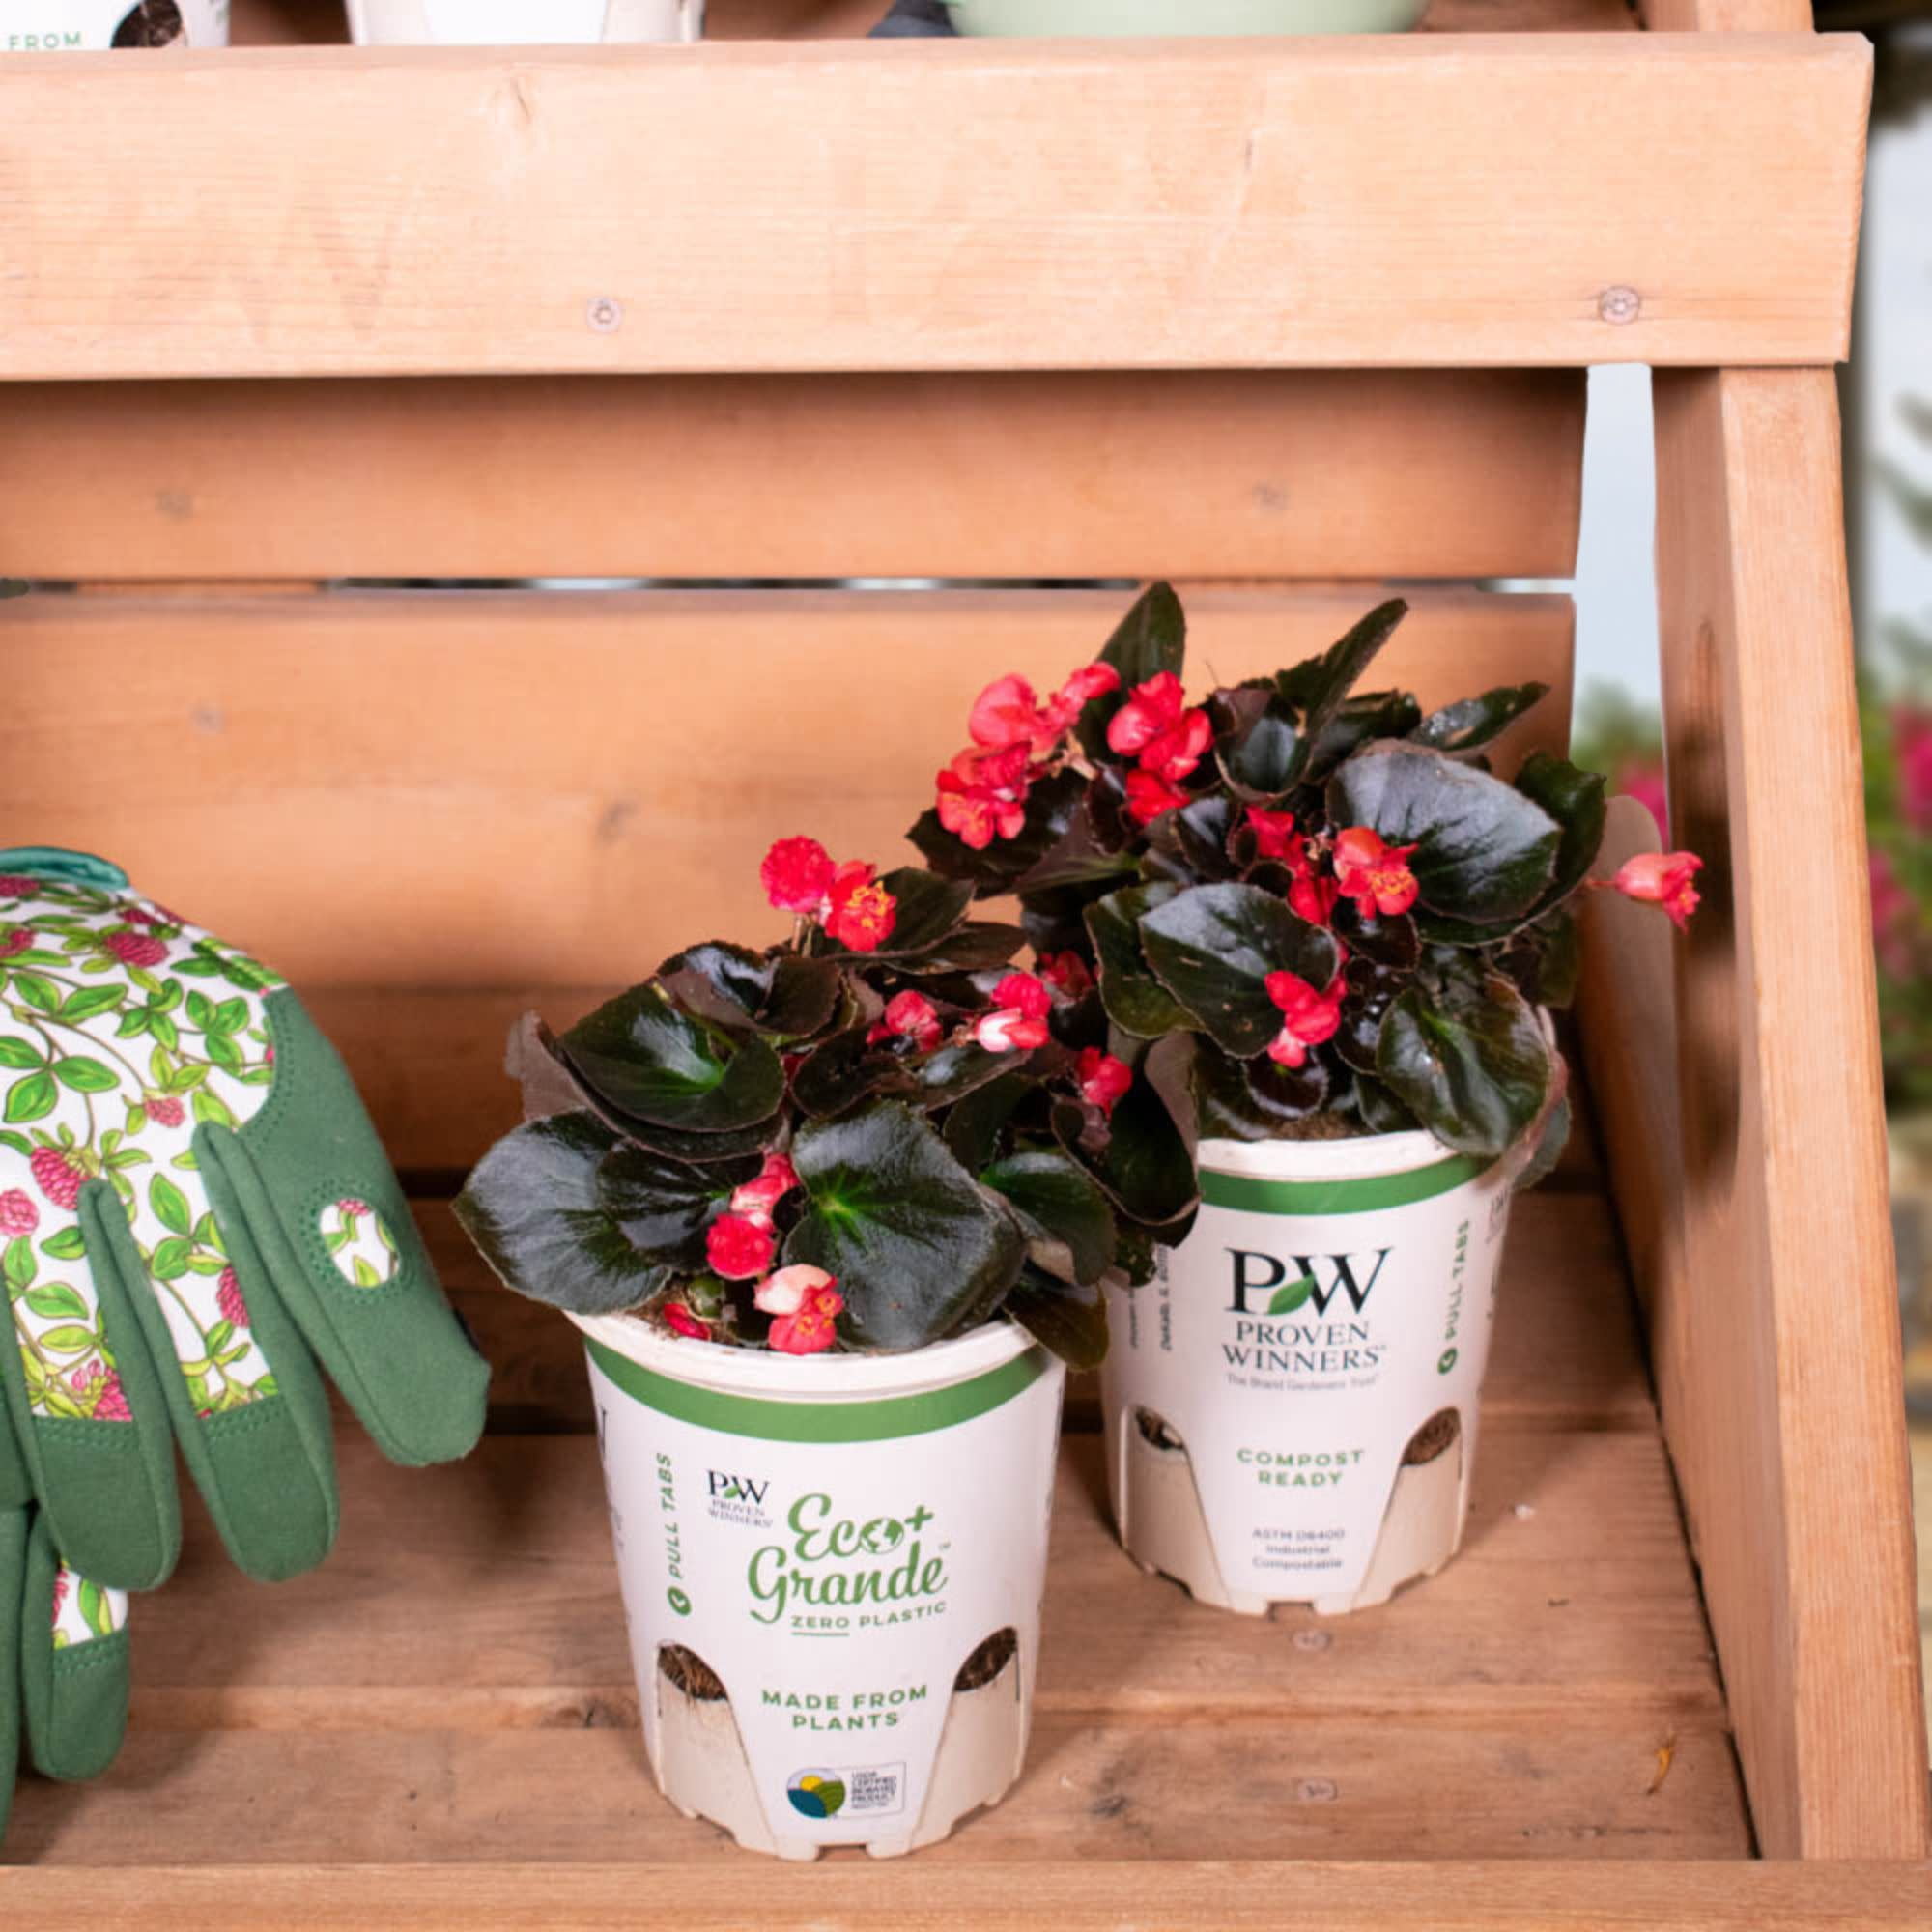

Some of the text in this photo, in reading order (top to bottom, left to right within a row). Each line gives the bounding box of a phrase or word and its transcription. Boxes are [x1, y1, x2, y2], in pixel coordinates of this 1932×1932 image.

[8, 31, 82, 50] FROM
[1452, 1219, 1469, 1279] TABS
[1236, 1320, 1370, 1346] PROVEN
[1236, 1449, 1365, 1467] COMPOST
[1258, 1470, 1343, 1487] READY
[656, 1452, 683, 1579] PULL TABS
[790, 1601, 947, 1629] ZERO PLASTIC
[761, 1684, 927, 1710] MADE FROM
[791, 1712, 899, 1731] PLANTS
